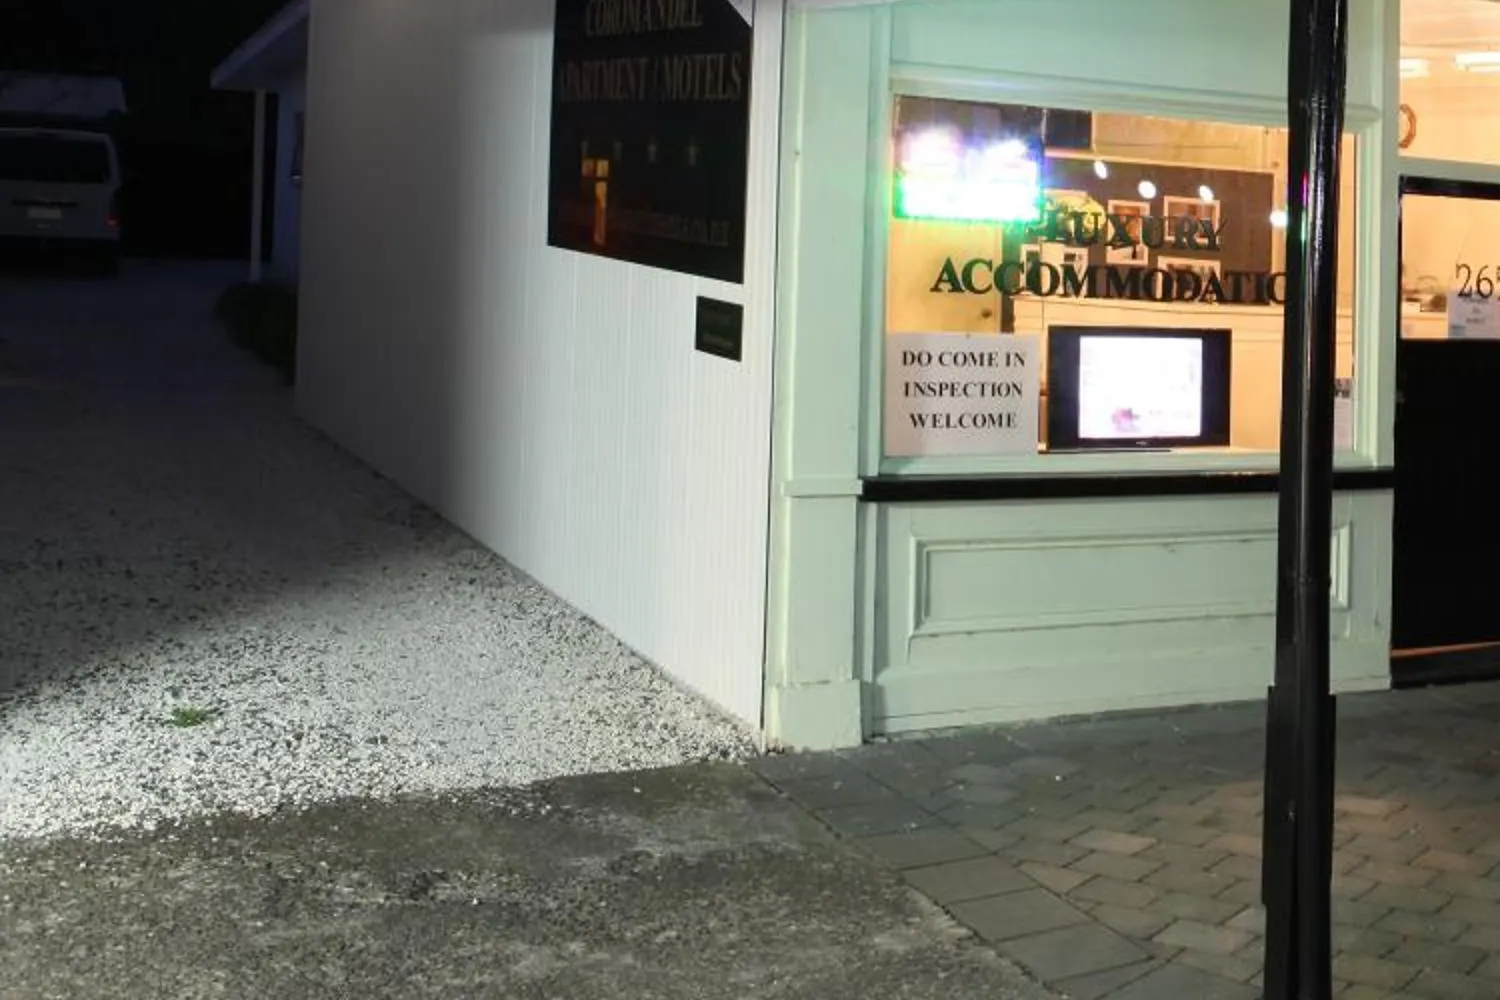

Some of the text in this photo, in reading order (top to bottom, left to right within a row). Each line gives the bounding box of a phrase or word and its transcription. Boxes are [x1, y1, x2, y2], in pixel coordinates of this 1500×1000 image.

[660, 53, 743, 102] MOTELS
[1045, 210, 1225, 253] LUXURY
[930, 257, 1287, 305] ACCOMMODATIO
[901, 351, 1026, 368] DO COME IN
[904, 381, 1023, 399] INSPECTION
[910, 412, 1017, 430] WELCOME
